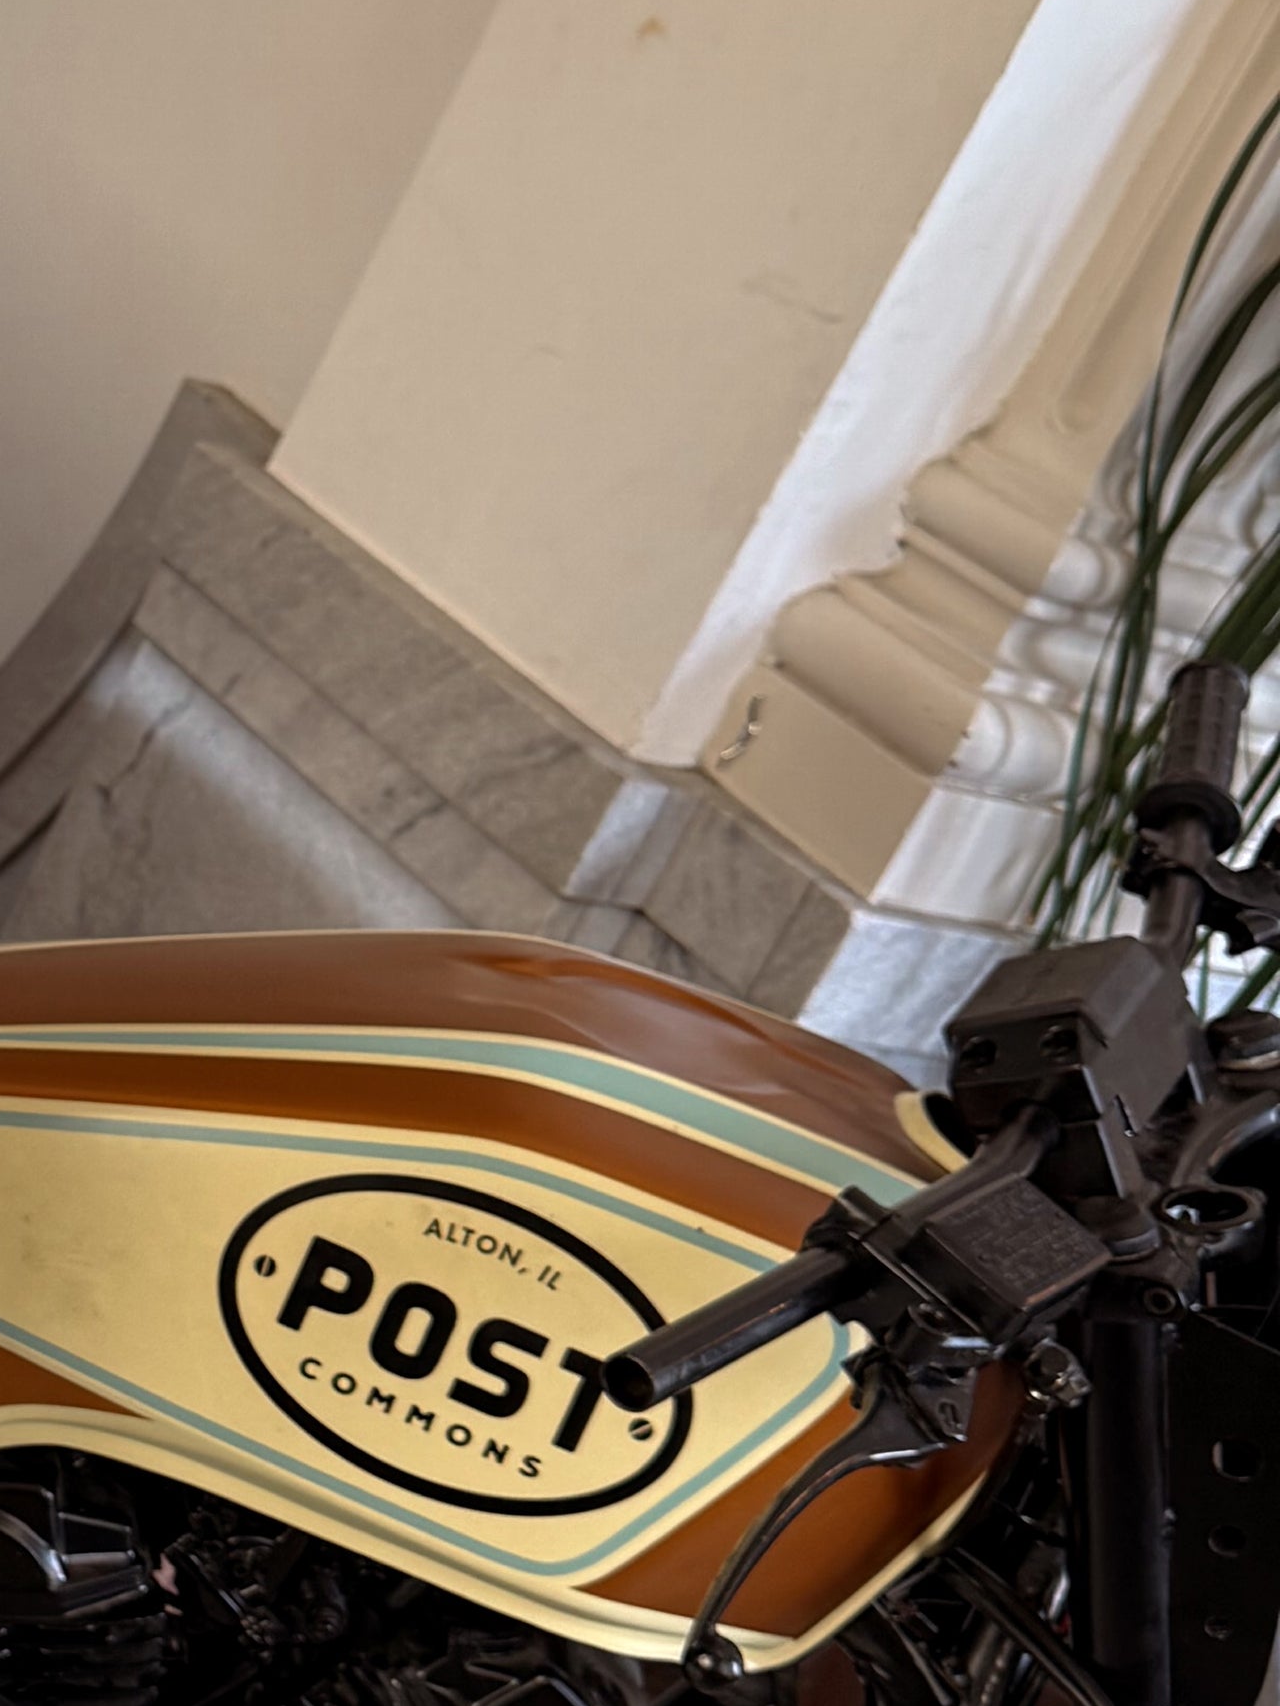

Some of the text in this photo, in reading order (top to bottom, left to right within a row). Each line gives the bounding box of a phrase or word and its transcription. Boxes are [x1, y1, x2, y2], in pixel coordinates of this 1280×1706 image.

[422, 1217, 564, 1292] ALTON, IL
[276, 1235, 606, 1453] POST
[298, 1356, 542, 1479] COMMONS
